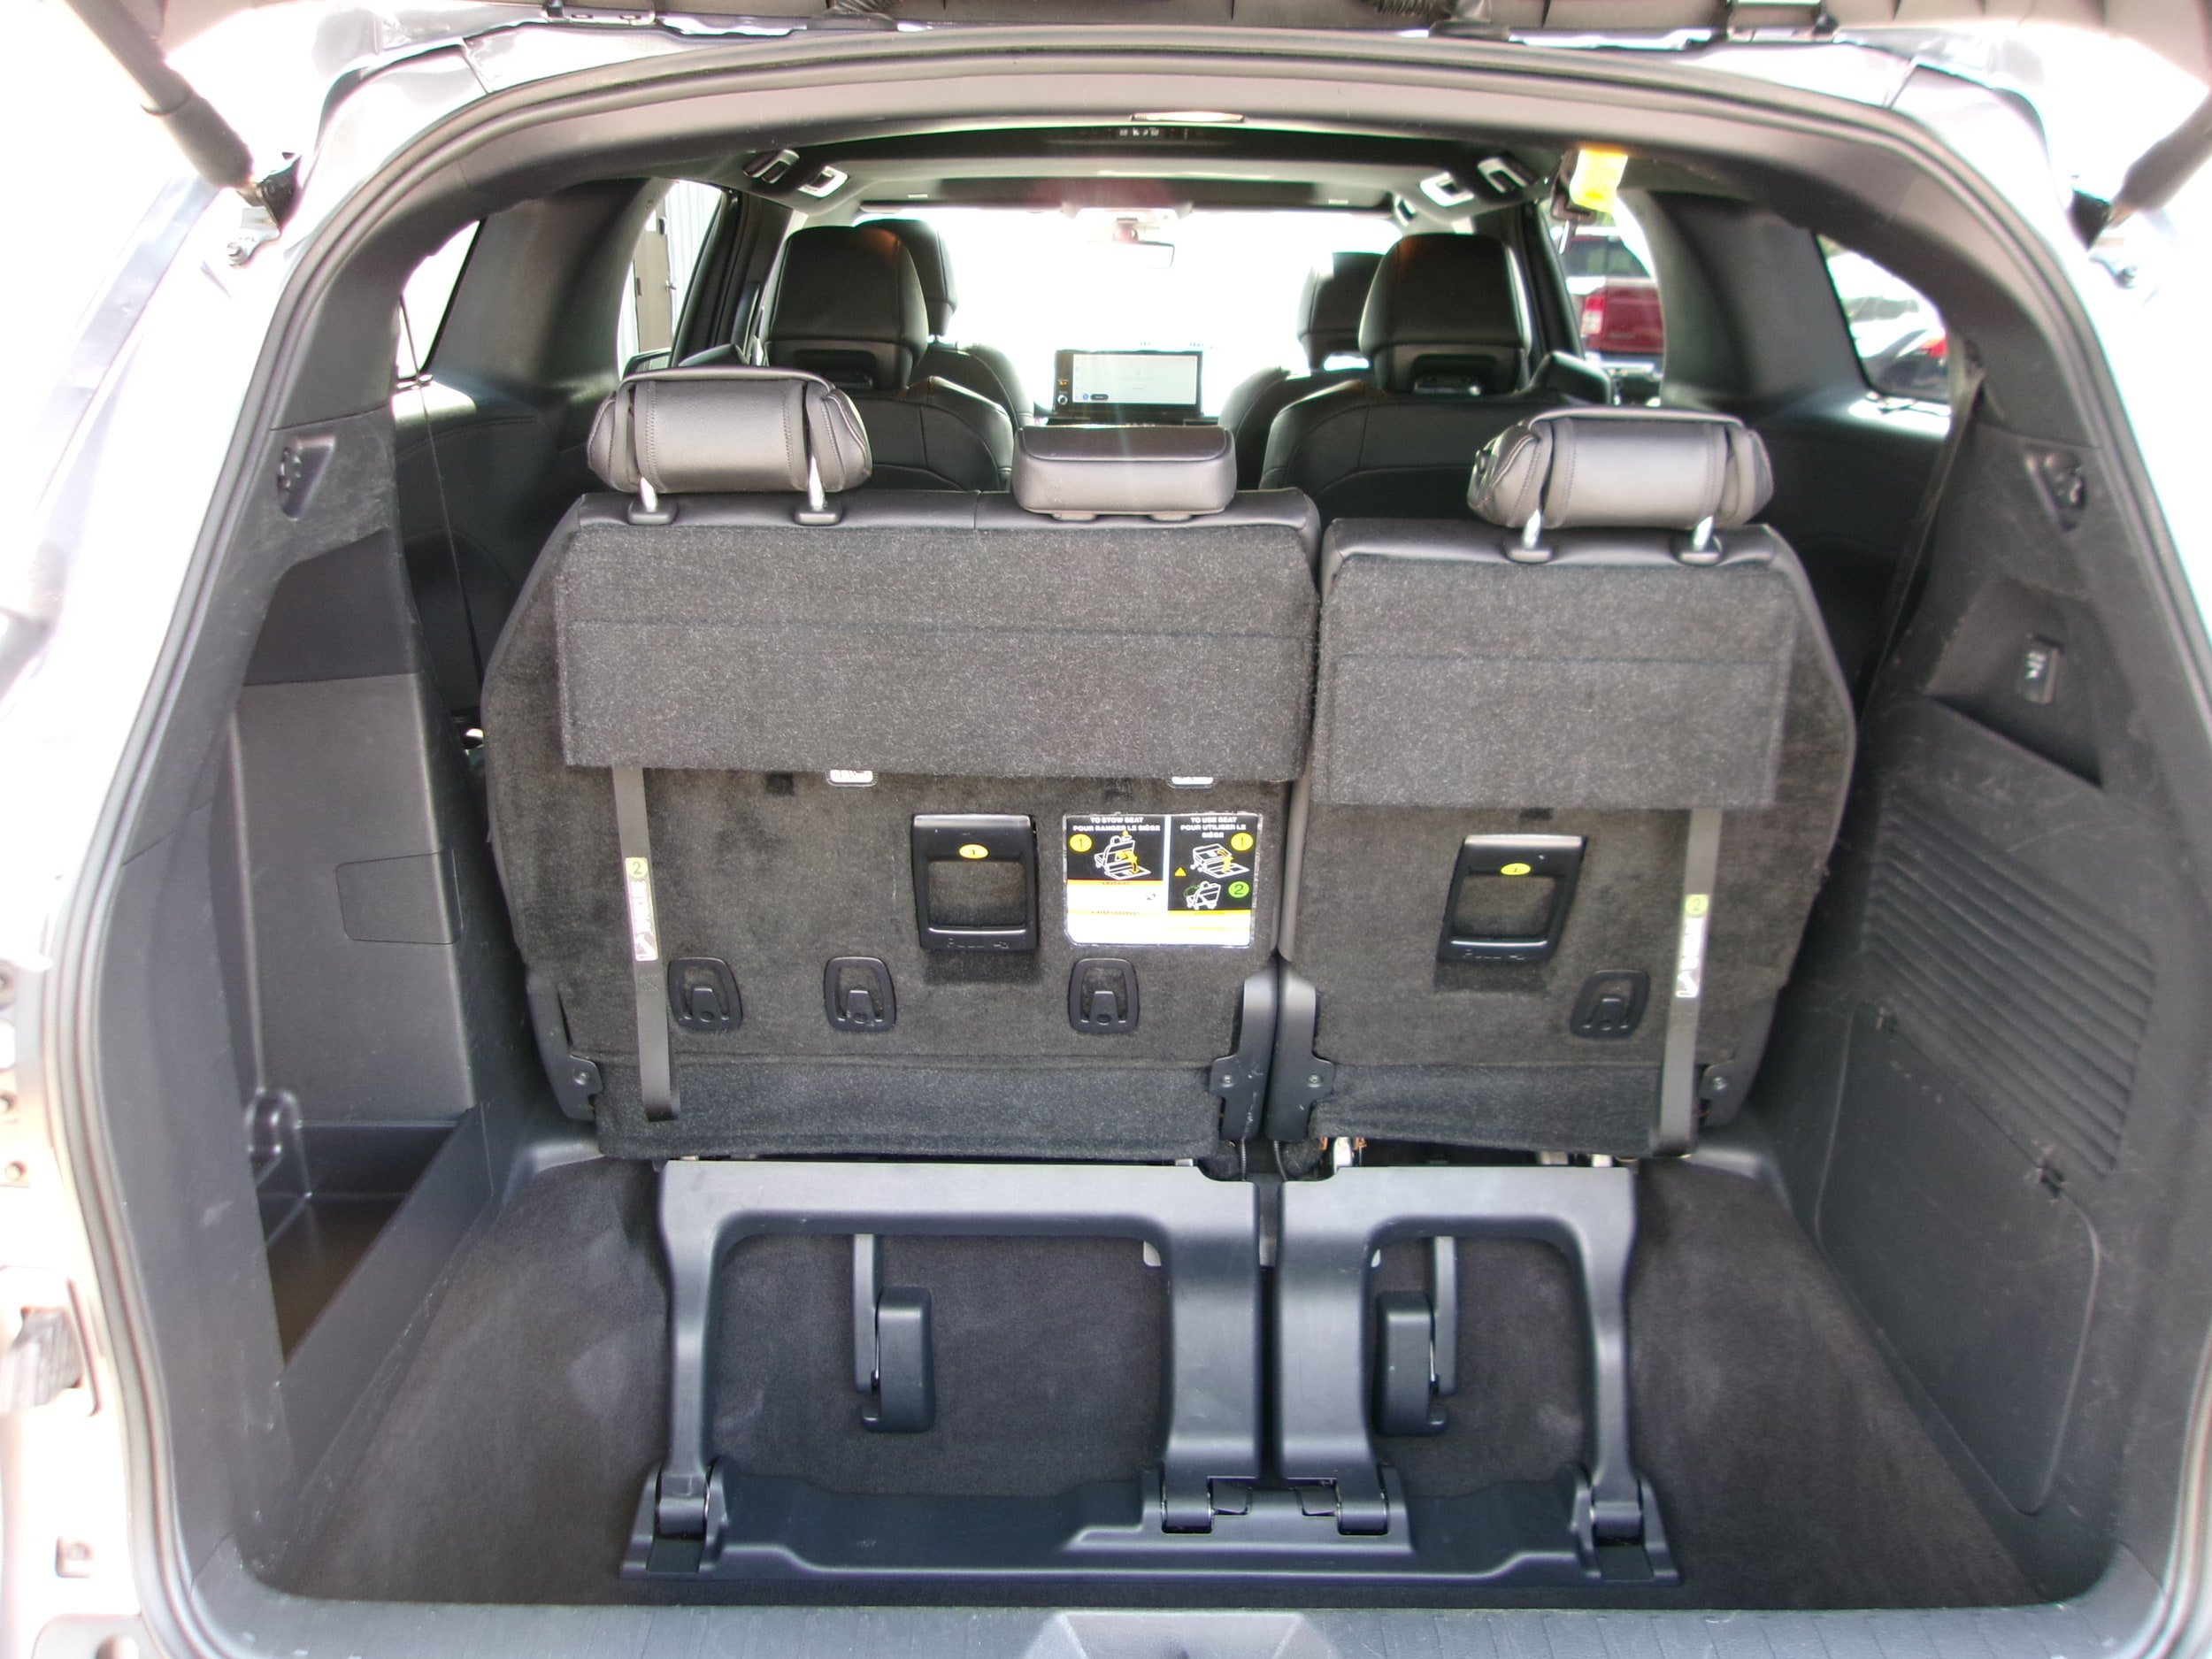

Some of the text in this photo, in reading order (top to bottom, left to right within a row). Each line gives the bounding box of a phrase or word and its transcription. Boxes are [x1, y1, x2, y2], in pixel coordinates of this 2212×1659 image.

[632, 861, 642, 875] 2
[1233, 884, 1244, 895] 2
[1691, 897, 1701, 912] 2
